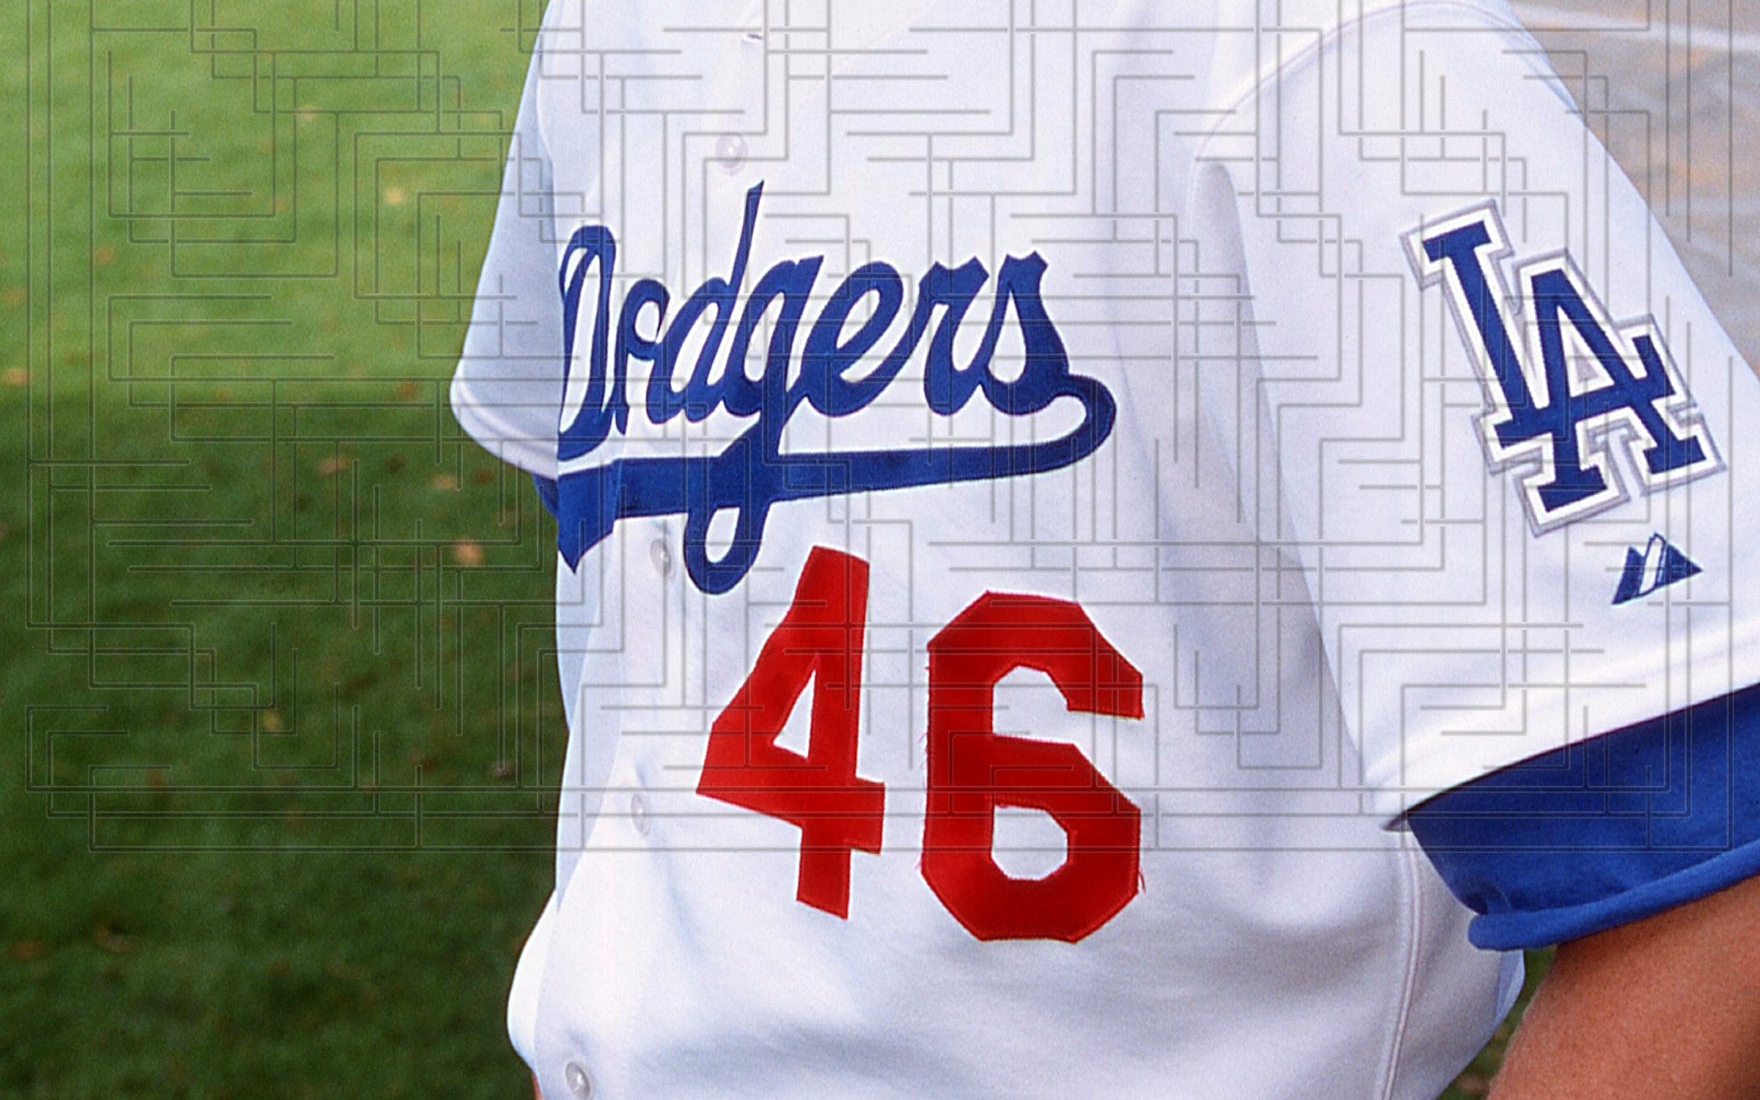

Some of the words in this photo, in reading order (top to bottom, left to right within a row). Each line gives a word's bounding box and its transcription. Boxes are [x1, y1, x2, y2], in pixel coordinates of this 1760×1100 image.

[557, 180, 1117, 594] Dodgers
[1412, 210, 1716, 525] LA
[696, 546, 1144, 942] 46
